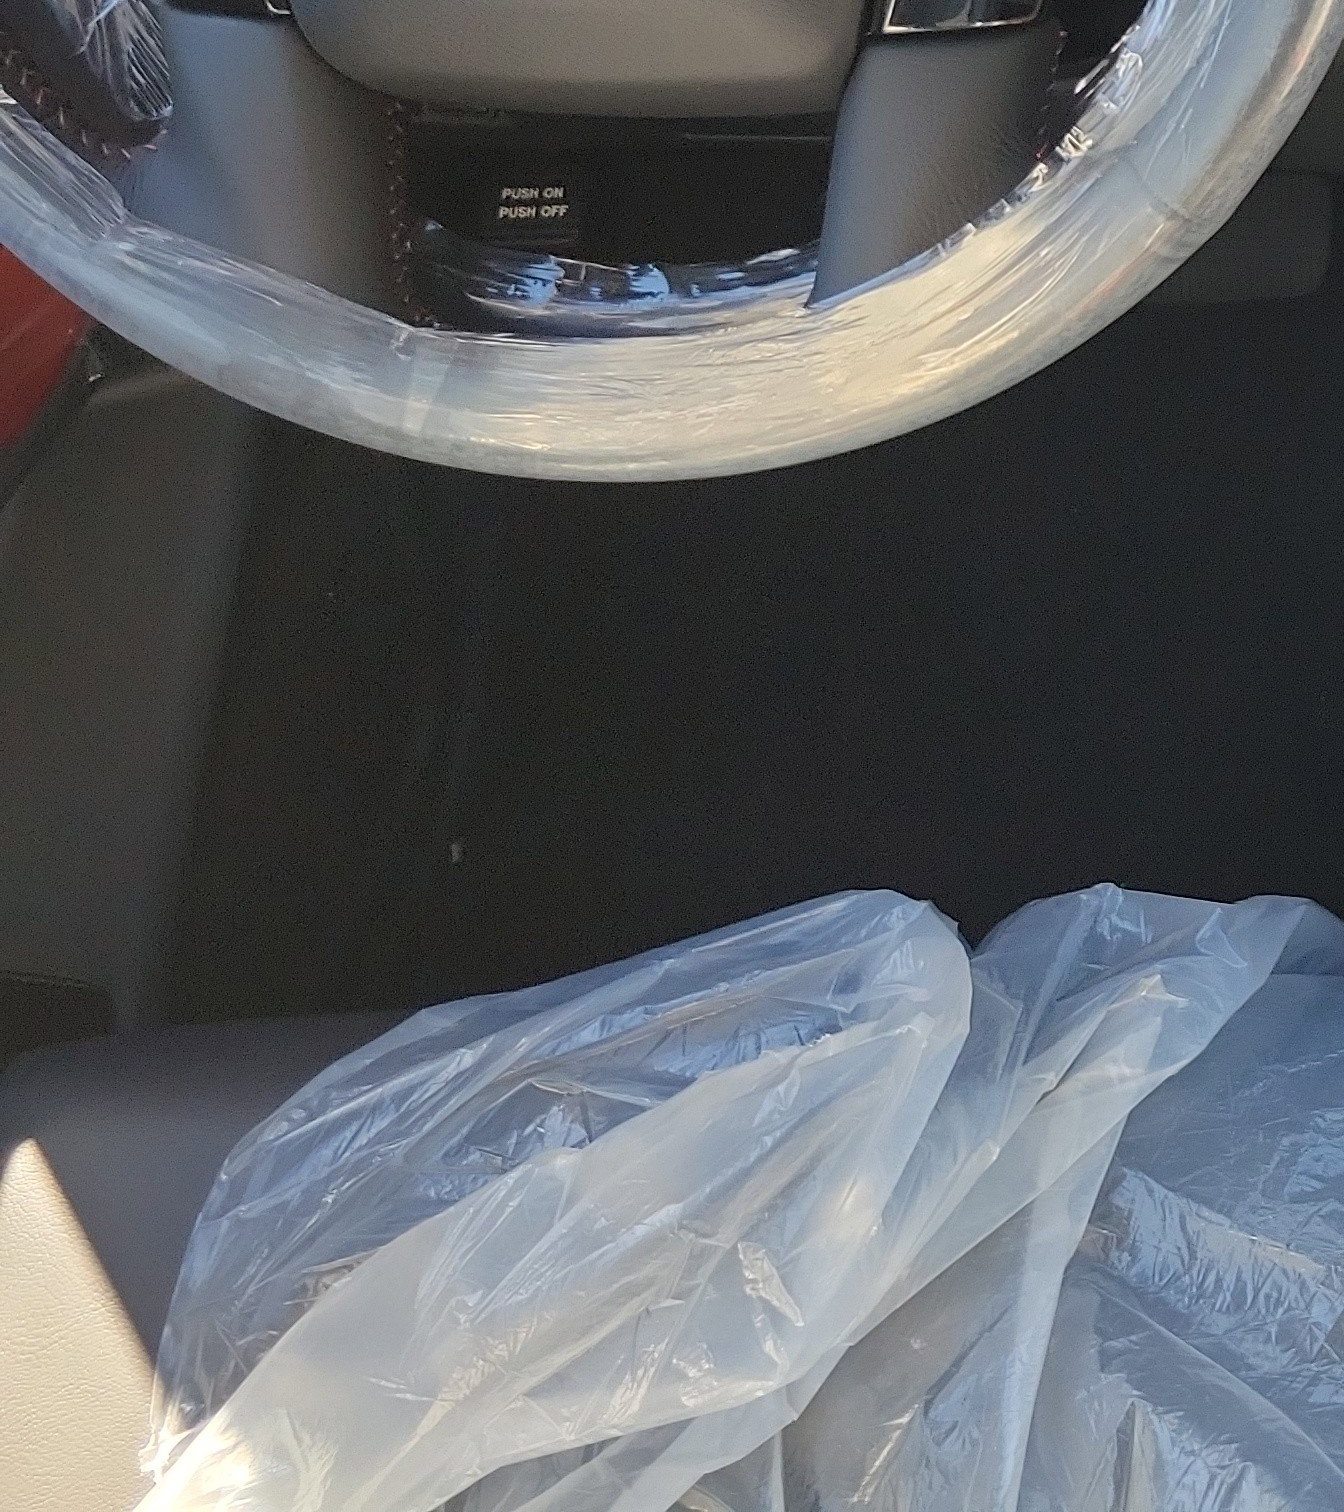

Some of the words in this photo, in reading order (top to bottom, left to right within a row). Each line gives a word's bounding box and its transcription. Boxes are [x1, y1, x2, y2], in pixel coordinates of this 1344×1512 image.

[501, 188, 539, 199] PUSH
[542, 187, 564, 198] ON
[499, 205, 536, 218] PUSH
[540, 205, 569, 217] OFF
